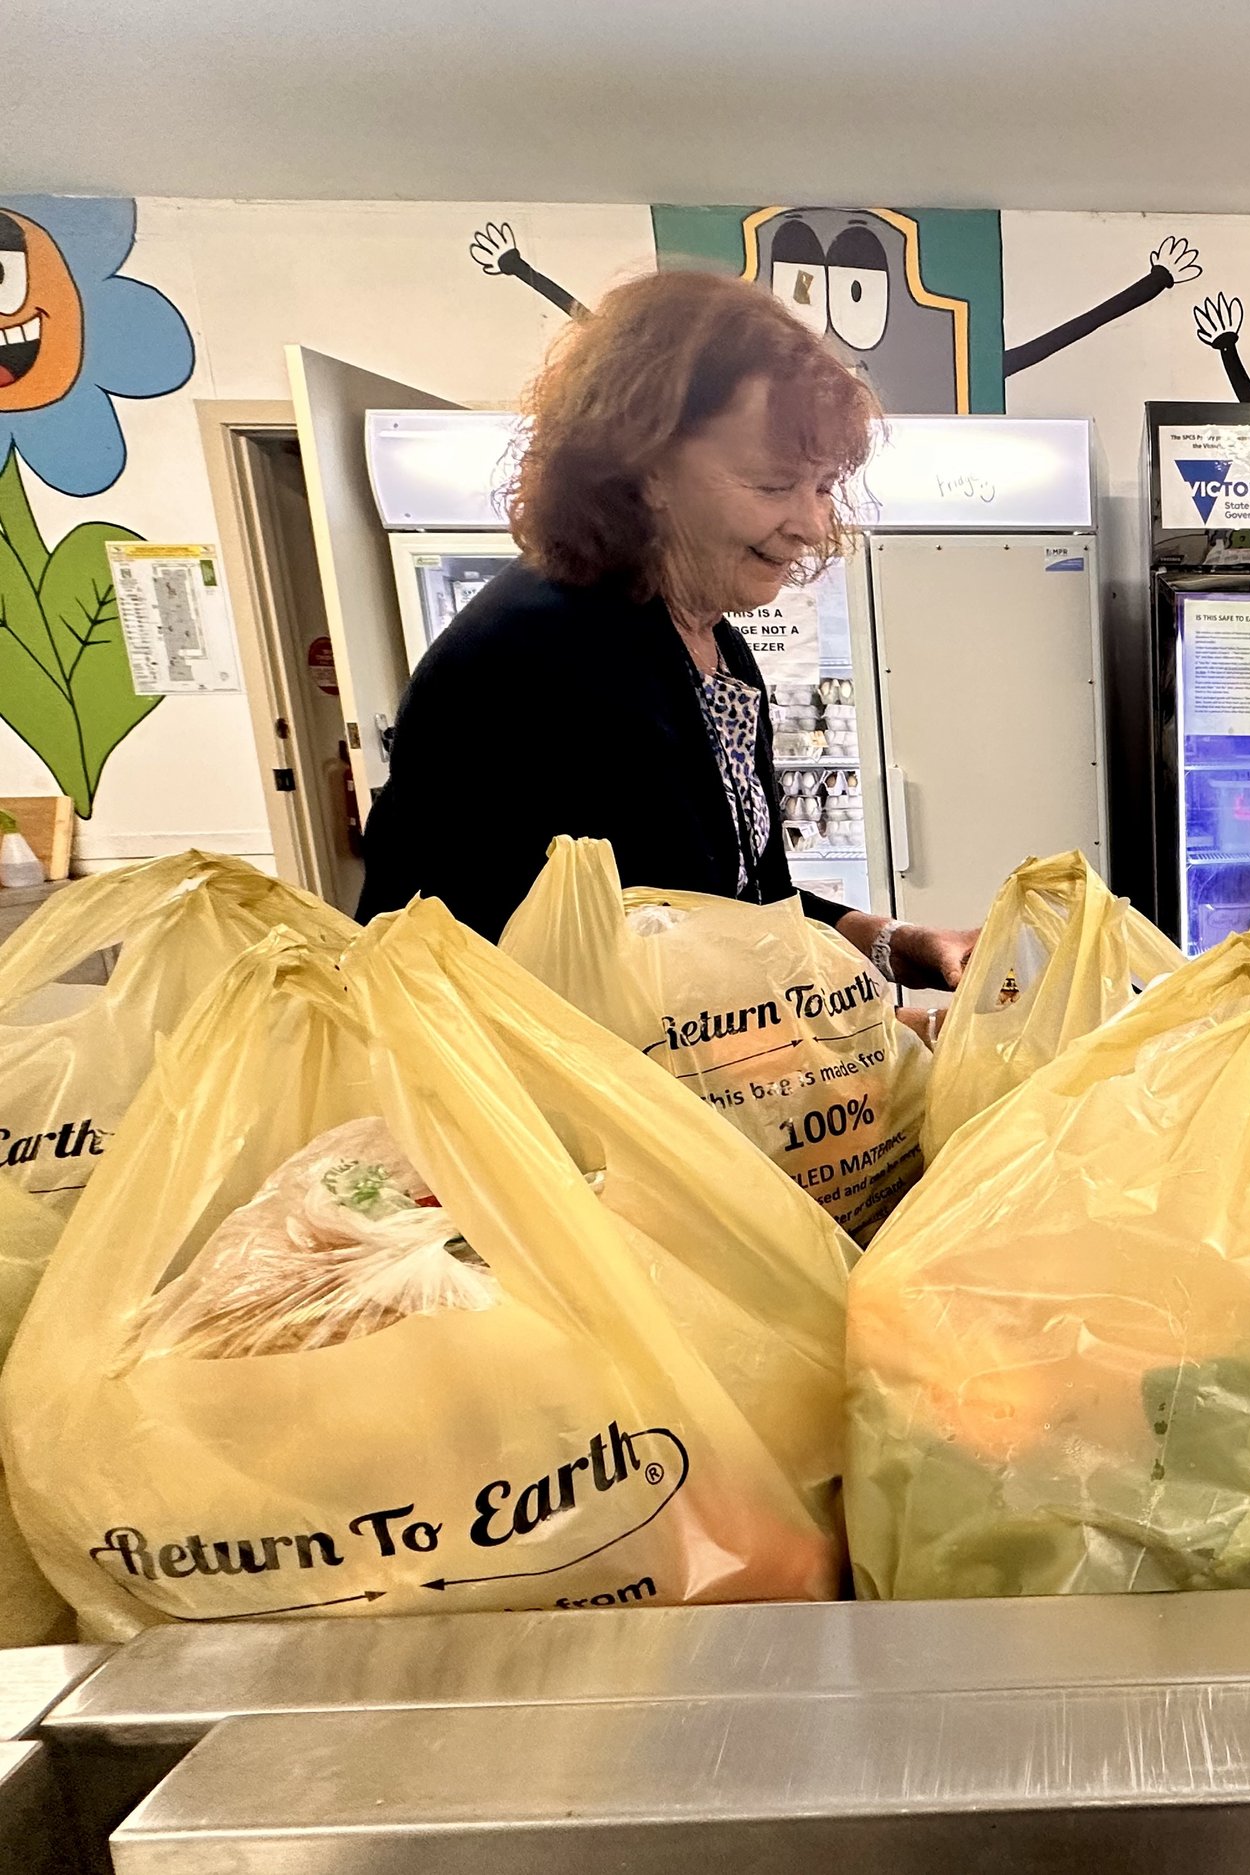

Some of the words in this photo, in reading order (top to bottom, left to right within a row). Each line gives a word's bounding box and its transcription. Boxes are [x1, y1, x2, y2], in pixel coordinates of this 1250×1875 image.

[1225, 502, 1250, 510] State
[758, 608, 770, 618] IS
[774, 608, 783, 618] A
[761, 626, 787, 635] NOT
[791, 626, 799, 635] A
[785, 984, 823, 1019] To
[821, 971, 880, 1017] arth
[701, 1089, 744, 1109] his
[820, 1060, 859, 1082] made
[859, 1048, 886, 1068] fro
[779, 1093, 875, 1151] 100%
[814, 1187, 840, 1206] sed
[844, 1176, 867, 1197] and
[90, 1526, 344, 1581] Return
[348, 1502, 442, 1558] To
